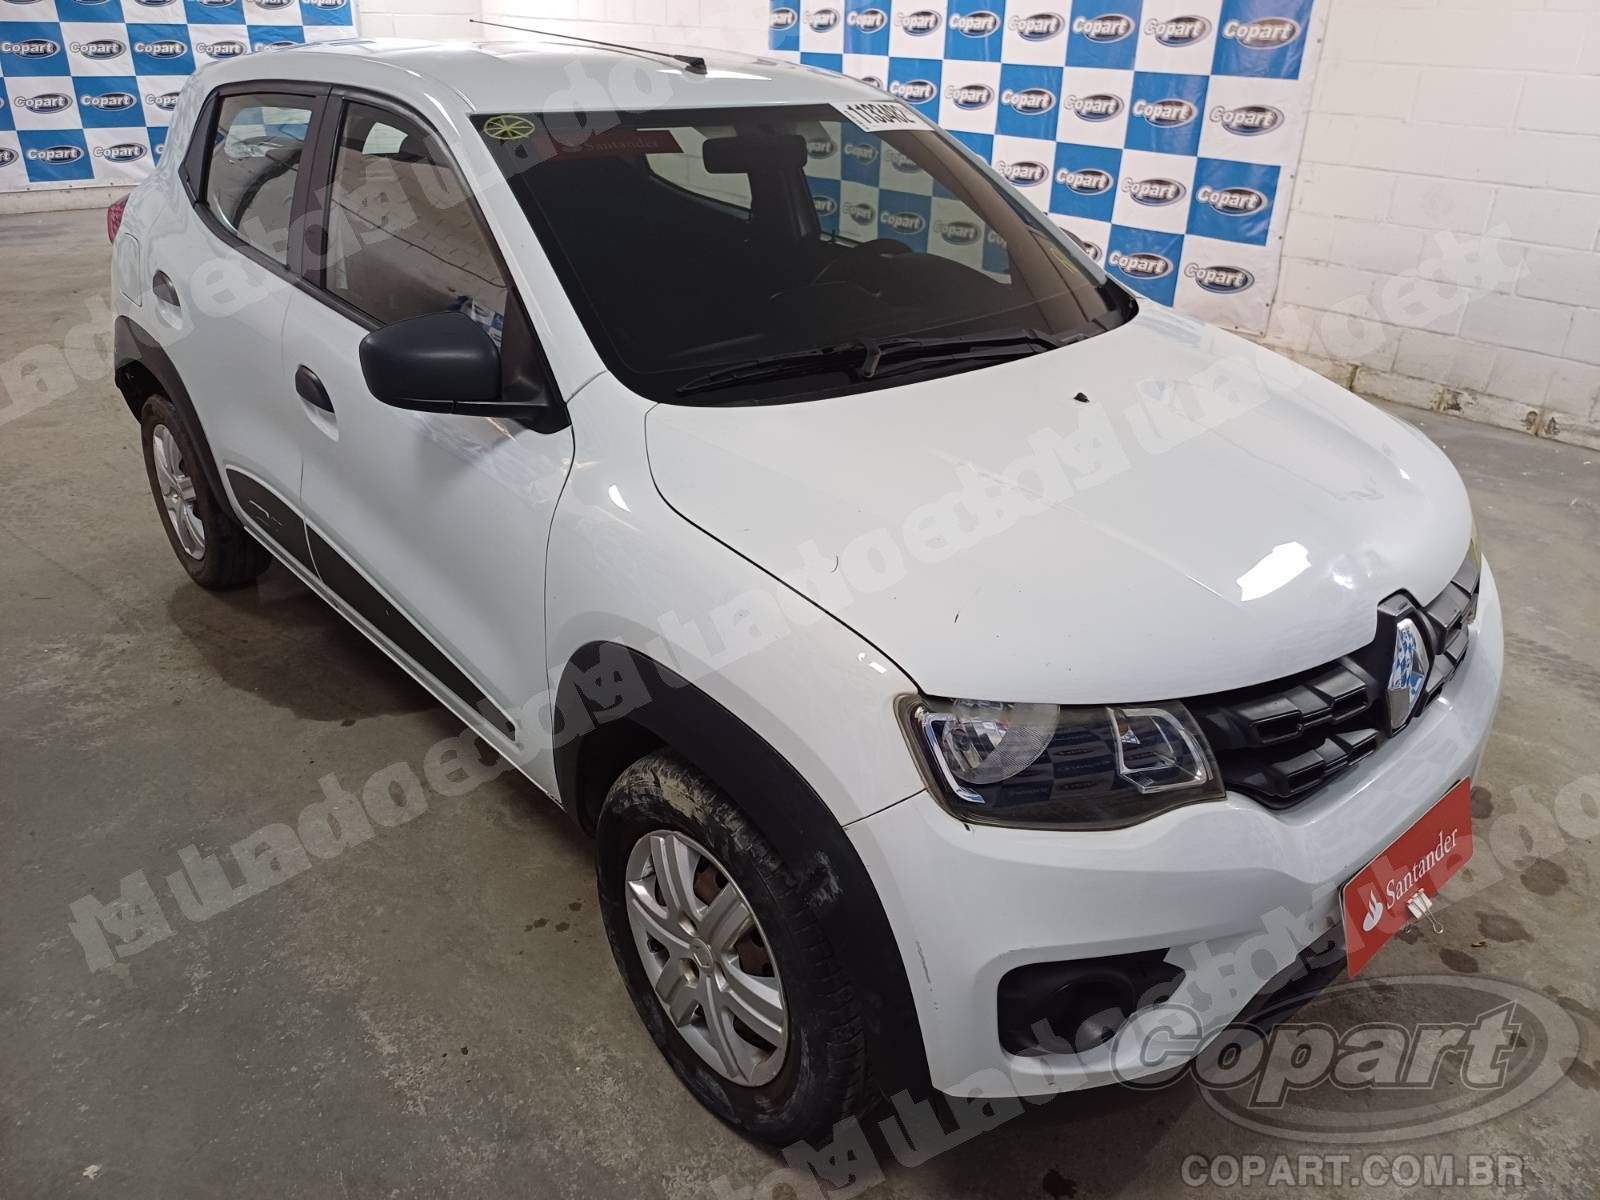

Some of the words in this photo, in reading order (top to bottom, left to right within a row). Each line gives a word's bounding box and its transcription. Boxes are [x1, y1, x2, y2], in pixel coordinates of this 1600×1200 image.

[950, 14, 997, 31] Copart
[1008, 16, 1057, 36] Copart
[1073, 17, 1128, 39] Copart
[1144, 19, 1202, 42] Copart
[1223, 20, 1292, 45] Copart
[1, 42, 54, 55] Copart
[70, 42, 120, 56] Copart
[134, 42, 181, 56] Copart
[196, 42, 240, 55] Copart
[15, 96, 66, 109] Copart
[81, 95, 131, 109] Copart
[146, 94, 178, 106] Copa
[944, 86, 990, 103] Copart
[1002, 91, 1050, 110] Copart
[1064, 95, 1117, 115] Copart
[1133, 101, 1190, 121] Copart
[1210, 106, 1275, 128] Copart
[27, 149, 79, 162] Copart
[94, 146, 140, 160] Copart
[1056, 168, 1108, 188] Copart
[1122, 178, 1176, 200] Copart
[1198, 187, 1260, 210] Copart
[880, 212, 920, 230] Copart
[934, 220, 979, 240] Copart
[1109, 251, 1166, 273] Copart
[1184, 263, 1245, 287] Copart
[1385, 828, 1459, 909] Santander
